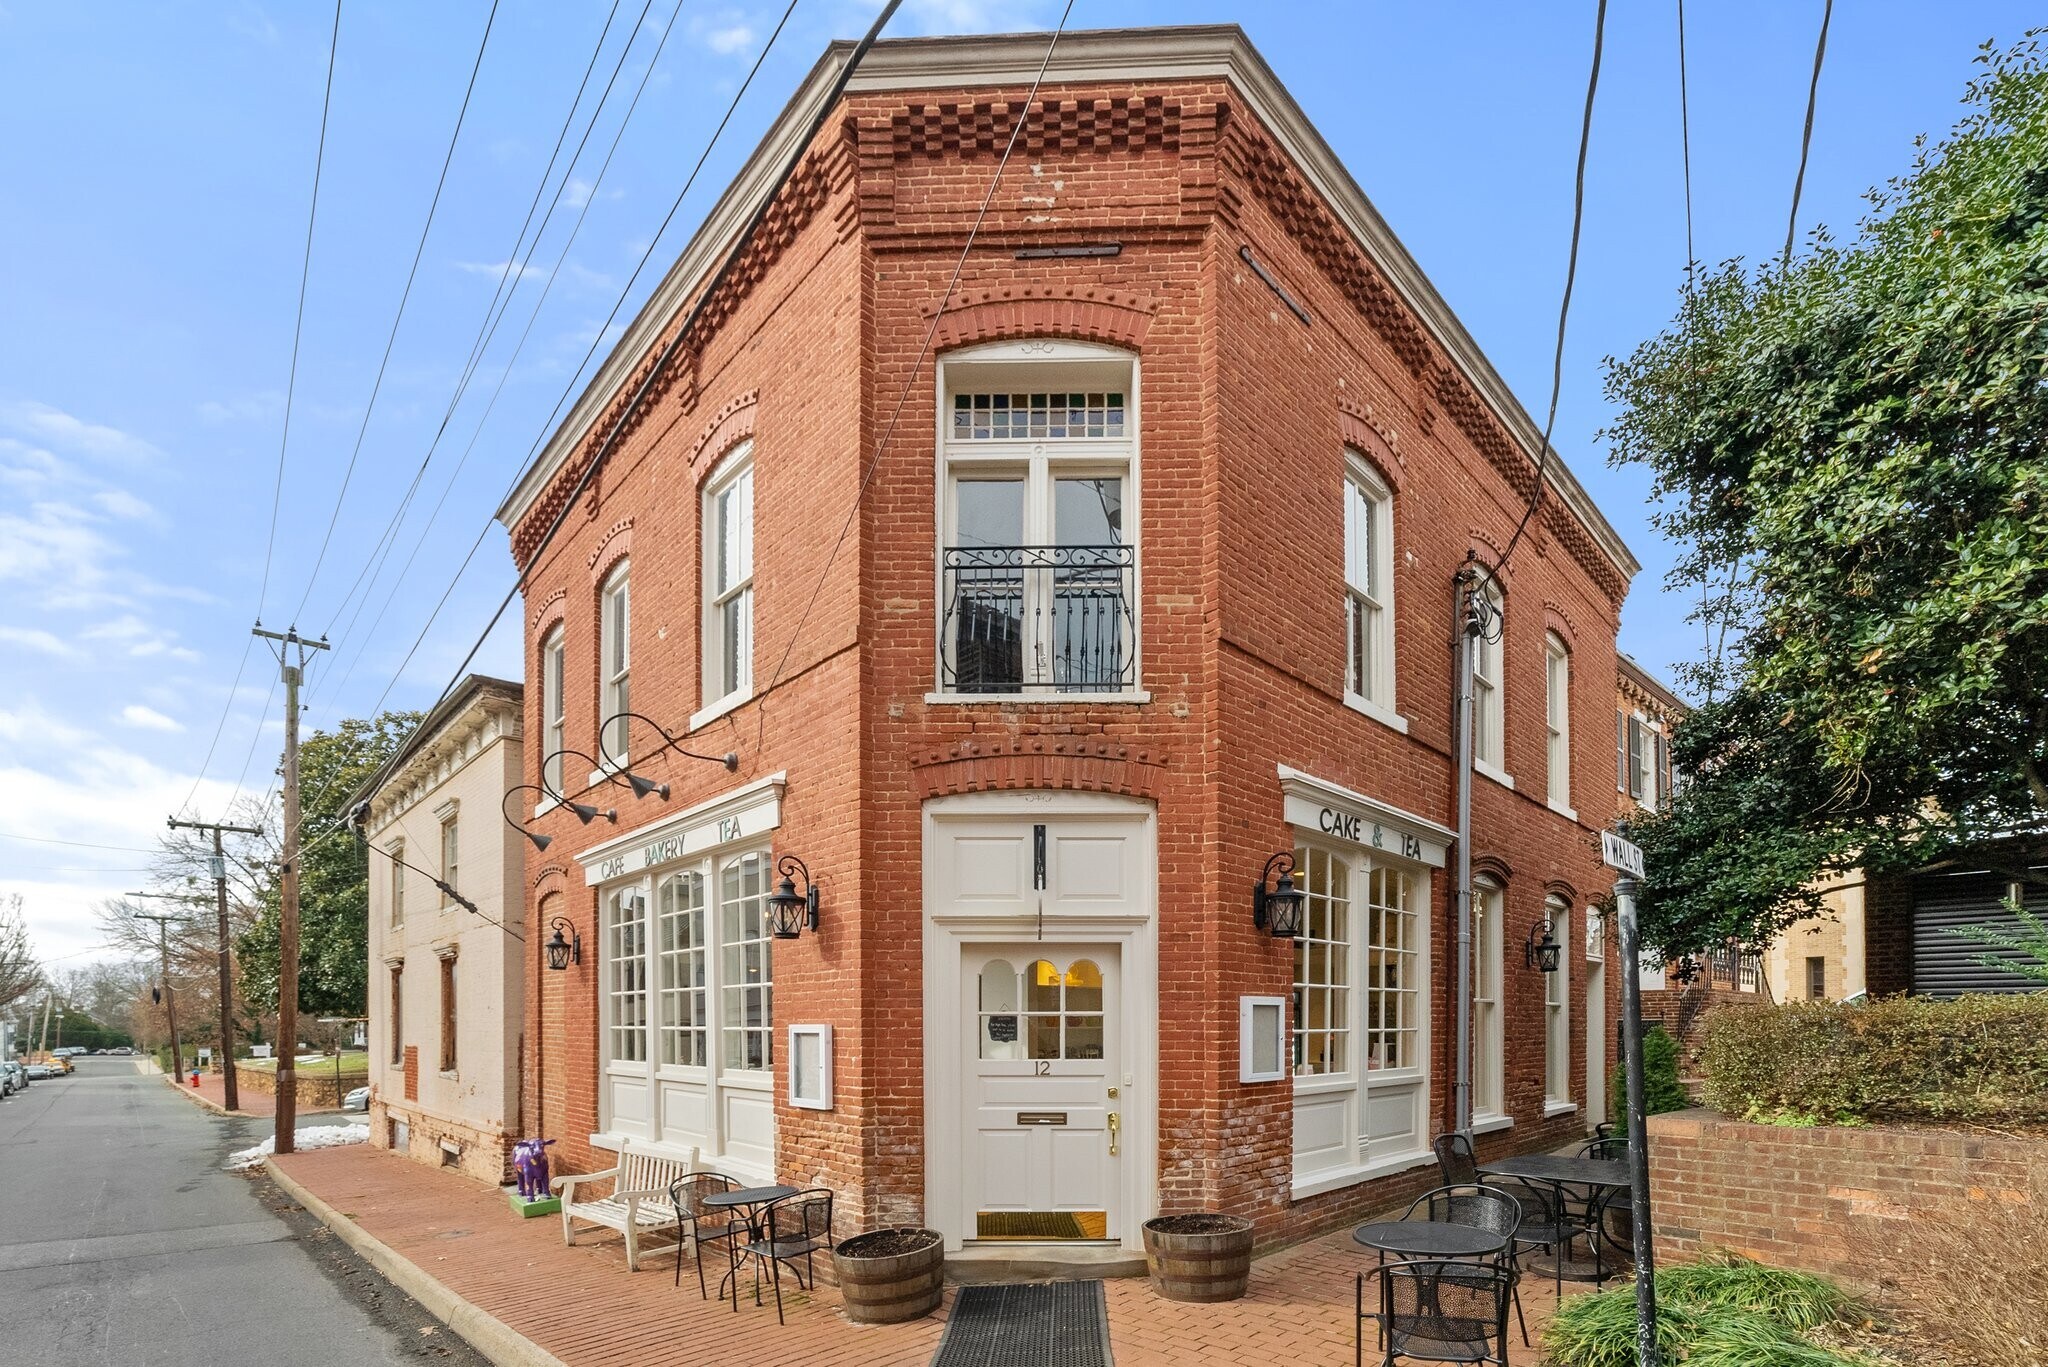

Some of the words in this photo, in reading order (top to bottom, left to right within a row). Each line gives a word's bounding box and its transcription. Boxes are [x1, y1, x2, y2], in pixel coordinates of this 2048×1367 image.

[644, 834, 686, 867] BAKERY
[717, 815, 742, 843] TEA
[1319, 808, 1361, 842] CAKE
[1371, 823, 1383, 849] &
[1401, 831, 1422, 861] TEA
[1610, 837, 1633, 869] WALL
[1034, 1061, 1050, 1075] 12
